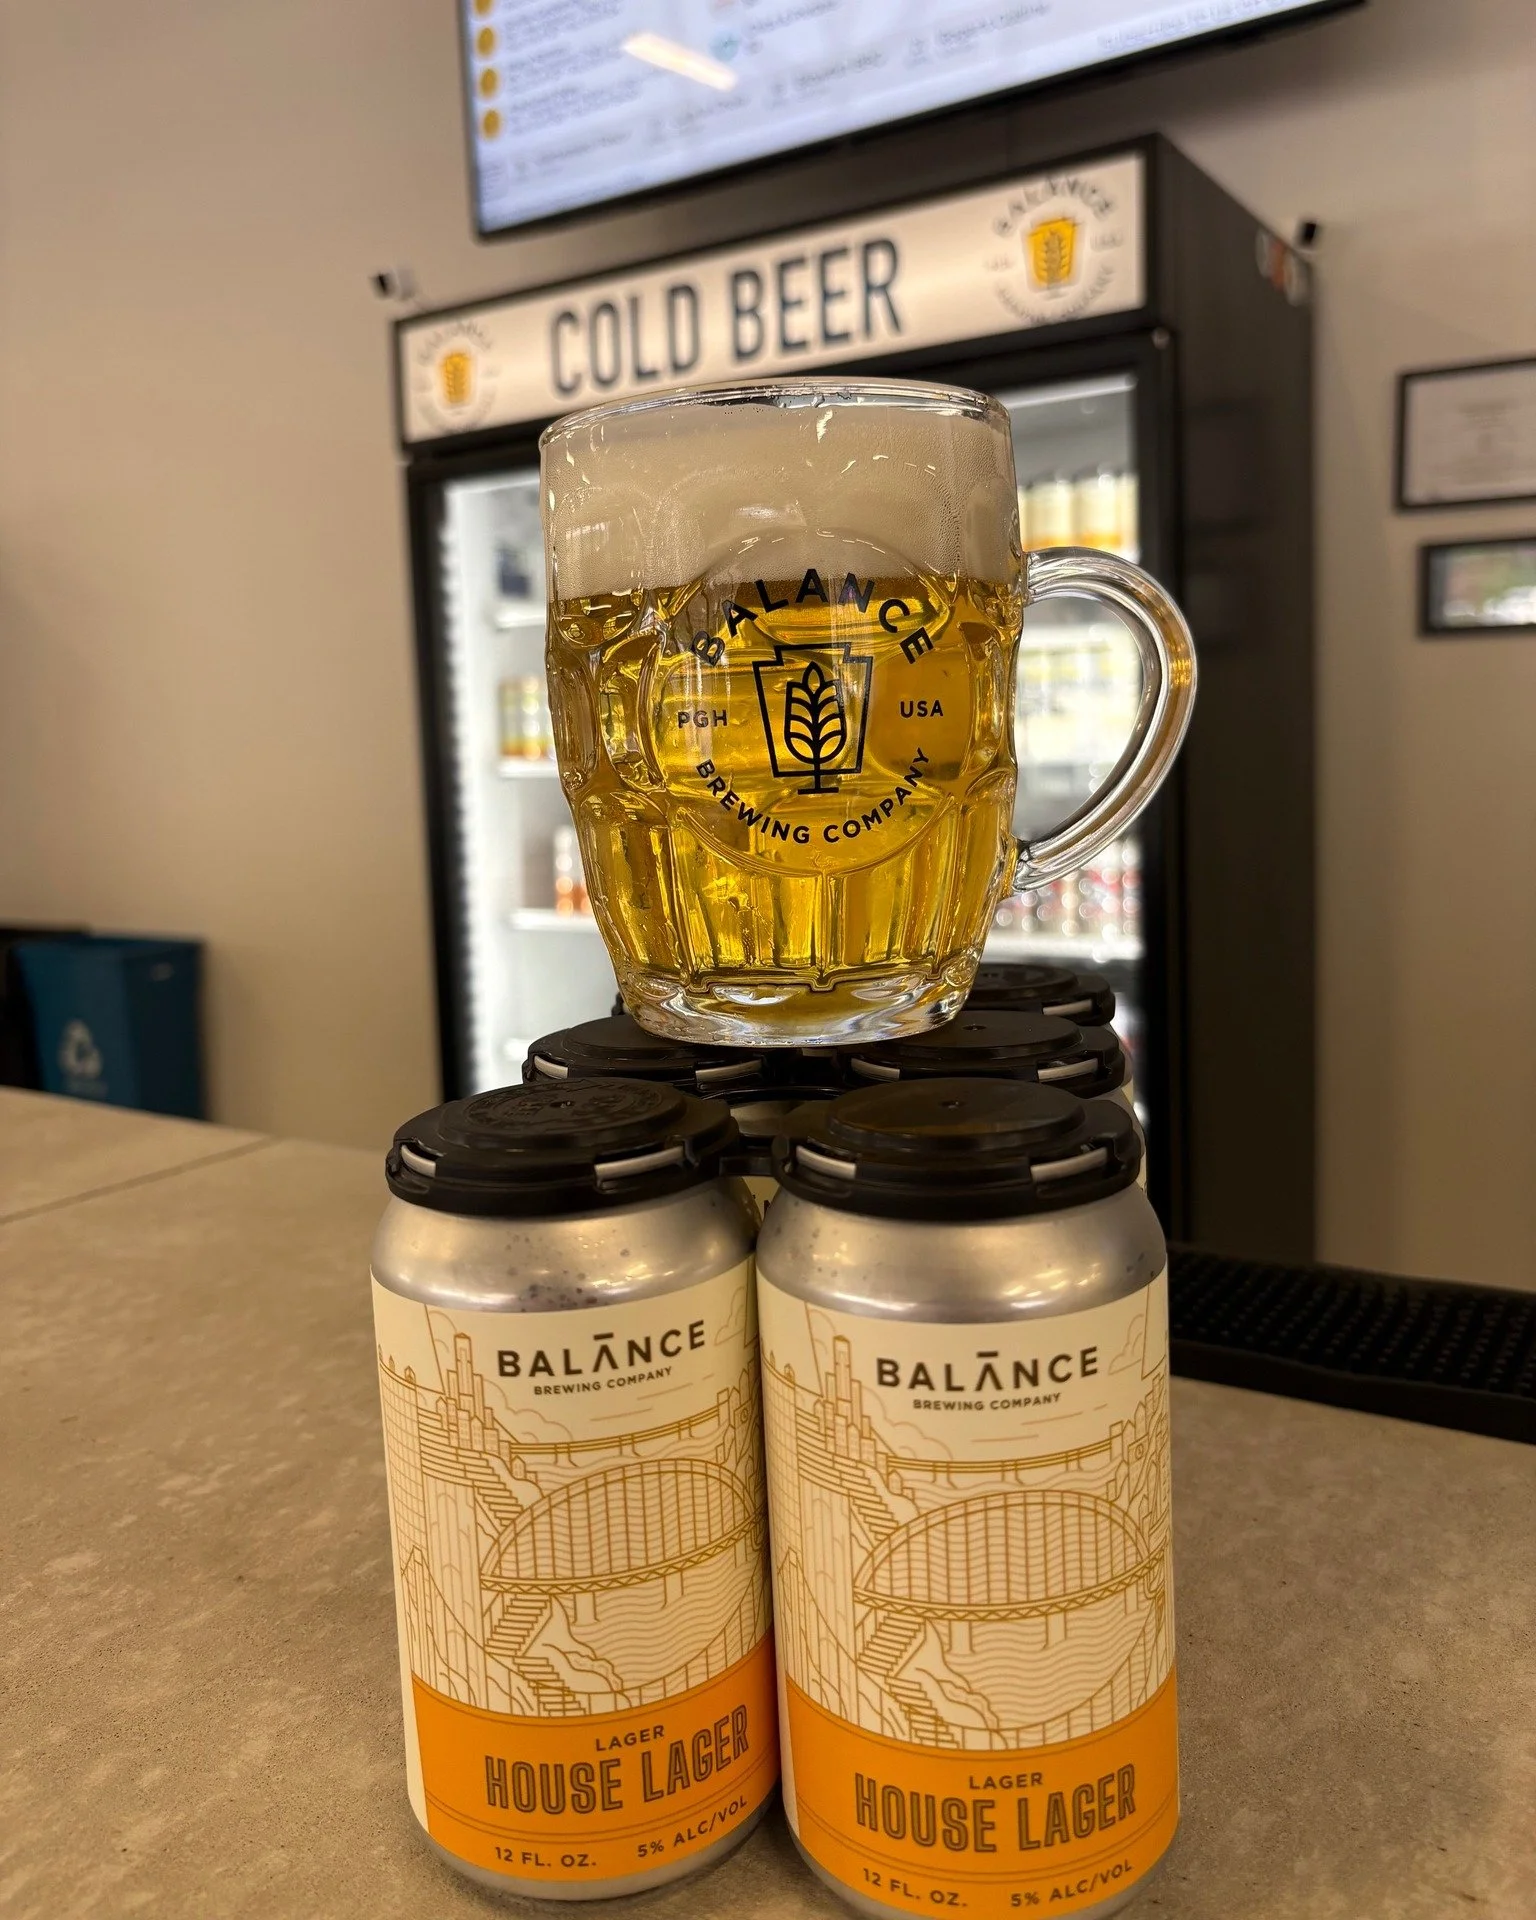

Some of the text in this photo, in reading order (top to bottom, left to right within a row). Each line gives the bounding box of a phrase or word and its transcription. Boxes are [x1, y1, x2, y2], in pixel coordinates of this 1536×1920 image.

[549, 282, 700, 398] COLD
[729, 236, 903, 363] BEER
[691, 568, 934, 666] BALANCE
[677, 709, 728, 729] PGH
[900, 700, 944, 718] USA
[696, 748, 929, 844] BREWING COMPANY
[534, 1366, 673, 1396] BREWING COMPANY
[913, 1392, 1062, 1411] BREWING COMPANY
[595, 1725, 665, 1751] LAGER
[484, 1704, 750, 1815] HOUSE LAGER
[968, 1772, 1044, 1790] LAGER
[636, 1795, 748, 1858] 5% ALC/VOL
[854, 1762, 1137, 1854] HOUSE LAGER
[494, 1846, 597, 1869] 12 FL. OZ.
[862, 1867, 968, 1908] 12 FL. OZ.
[1010, 1859, 1132, 1908] 5% ALC/VOL
